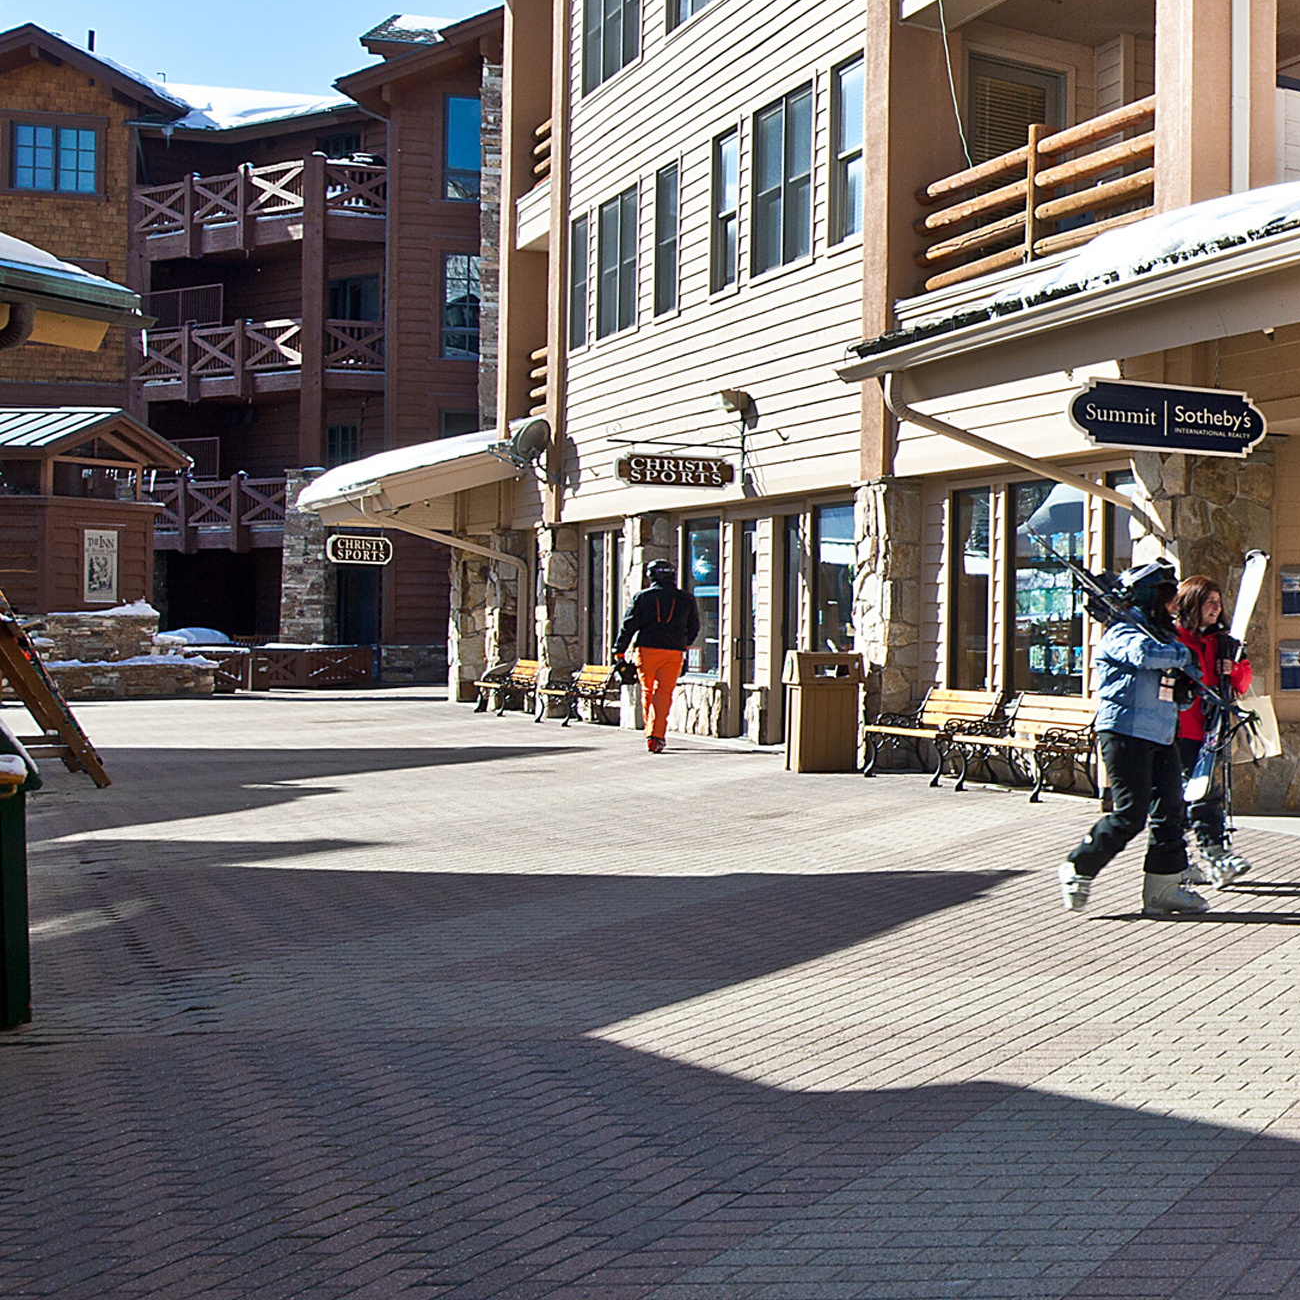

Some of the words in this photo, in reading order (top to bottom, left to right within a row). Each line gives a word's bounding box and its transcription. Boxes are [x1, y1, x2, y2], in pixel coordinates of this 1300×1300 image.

[1085, 403, 1157, 426] Summit
[1174, 405, 1252, 432] Sotheby's
[1174, 427, 1227, 438] INTERNATIONAL
[1228, 432, 1251, 440] REALTY
[630, 457, 721, 473] CHRISTY
[630, 469, 722, 485] SPORTS
[337, 538, 386, 551] CHRISTY
[337, 549, 386, 561] SPORTS
